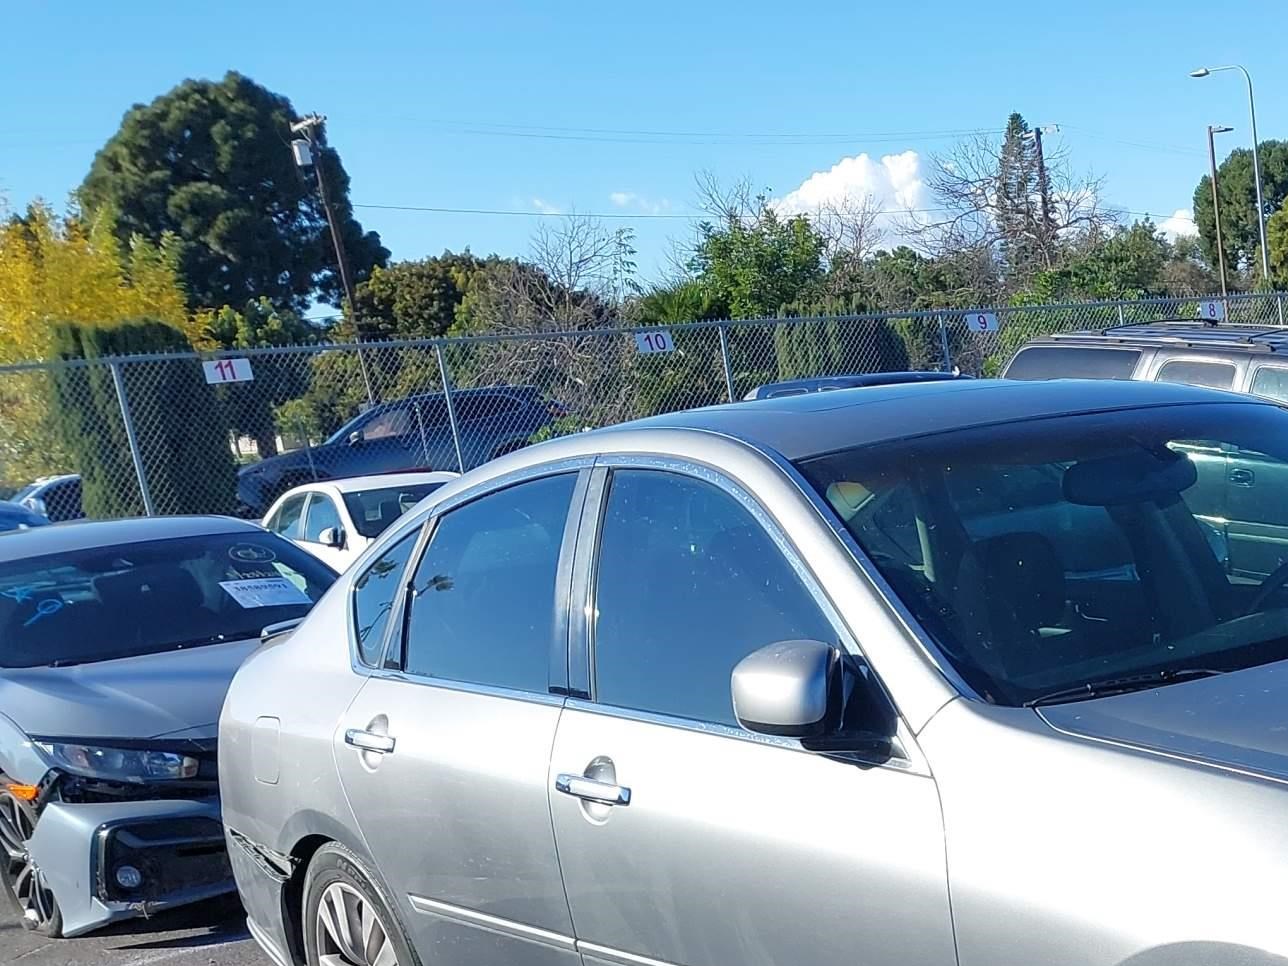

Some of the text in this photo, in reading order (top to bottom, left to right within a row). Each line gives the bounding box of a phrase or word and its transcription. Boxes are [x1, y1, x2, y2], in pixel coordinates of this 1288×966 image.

[1208, 303, 1216, 317] 8
[977, 315, 988, 330] 9
[644, 333, 667, 351] 10
[214, 360, 237, 381] 11
